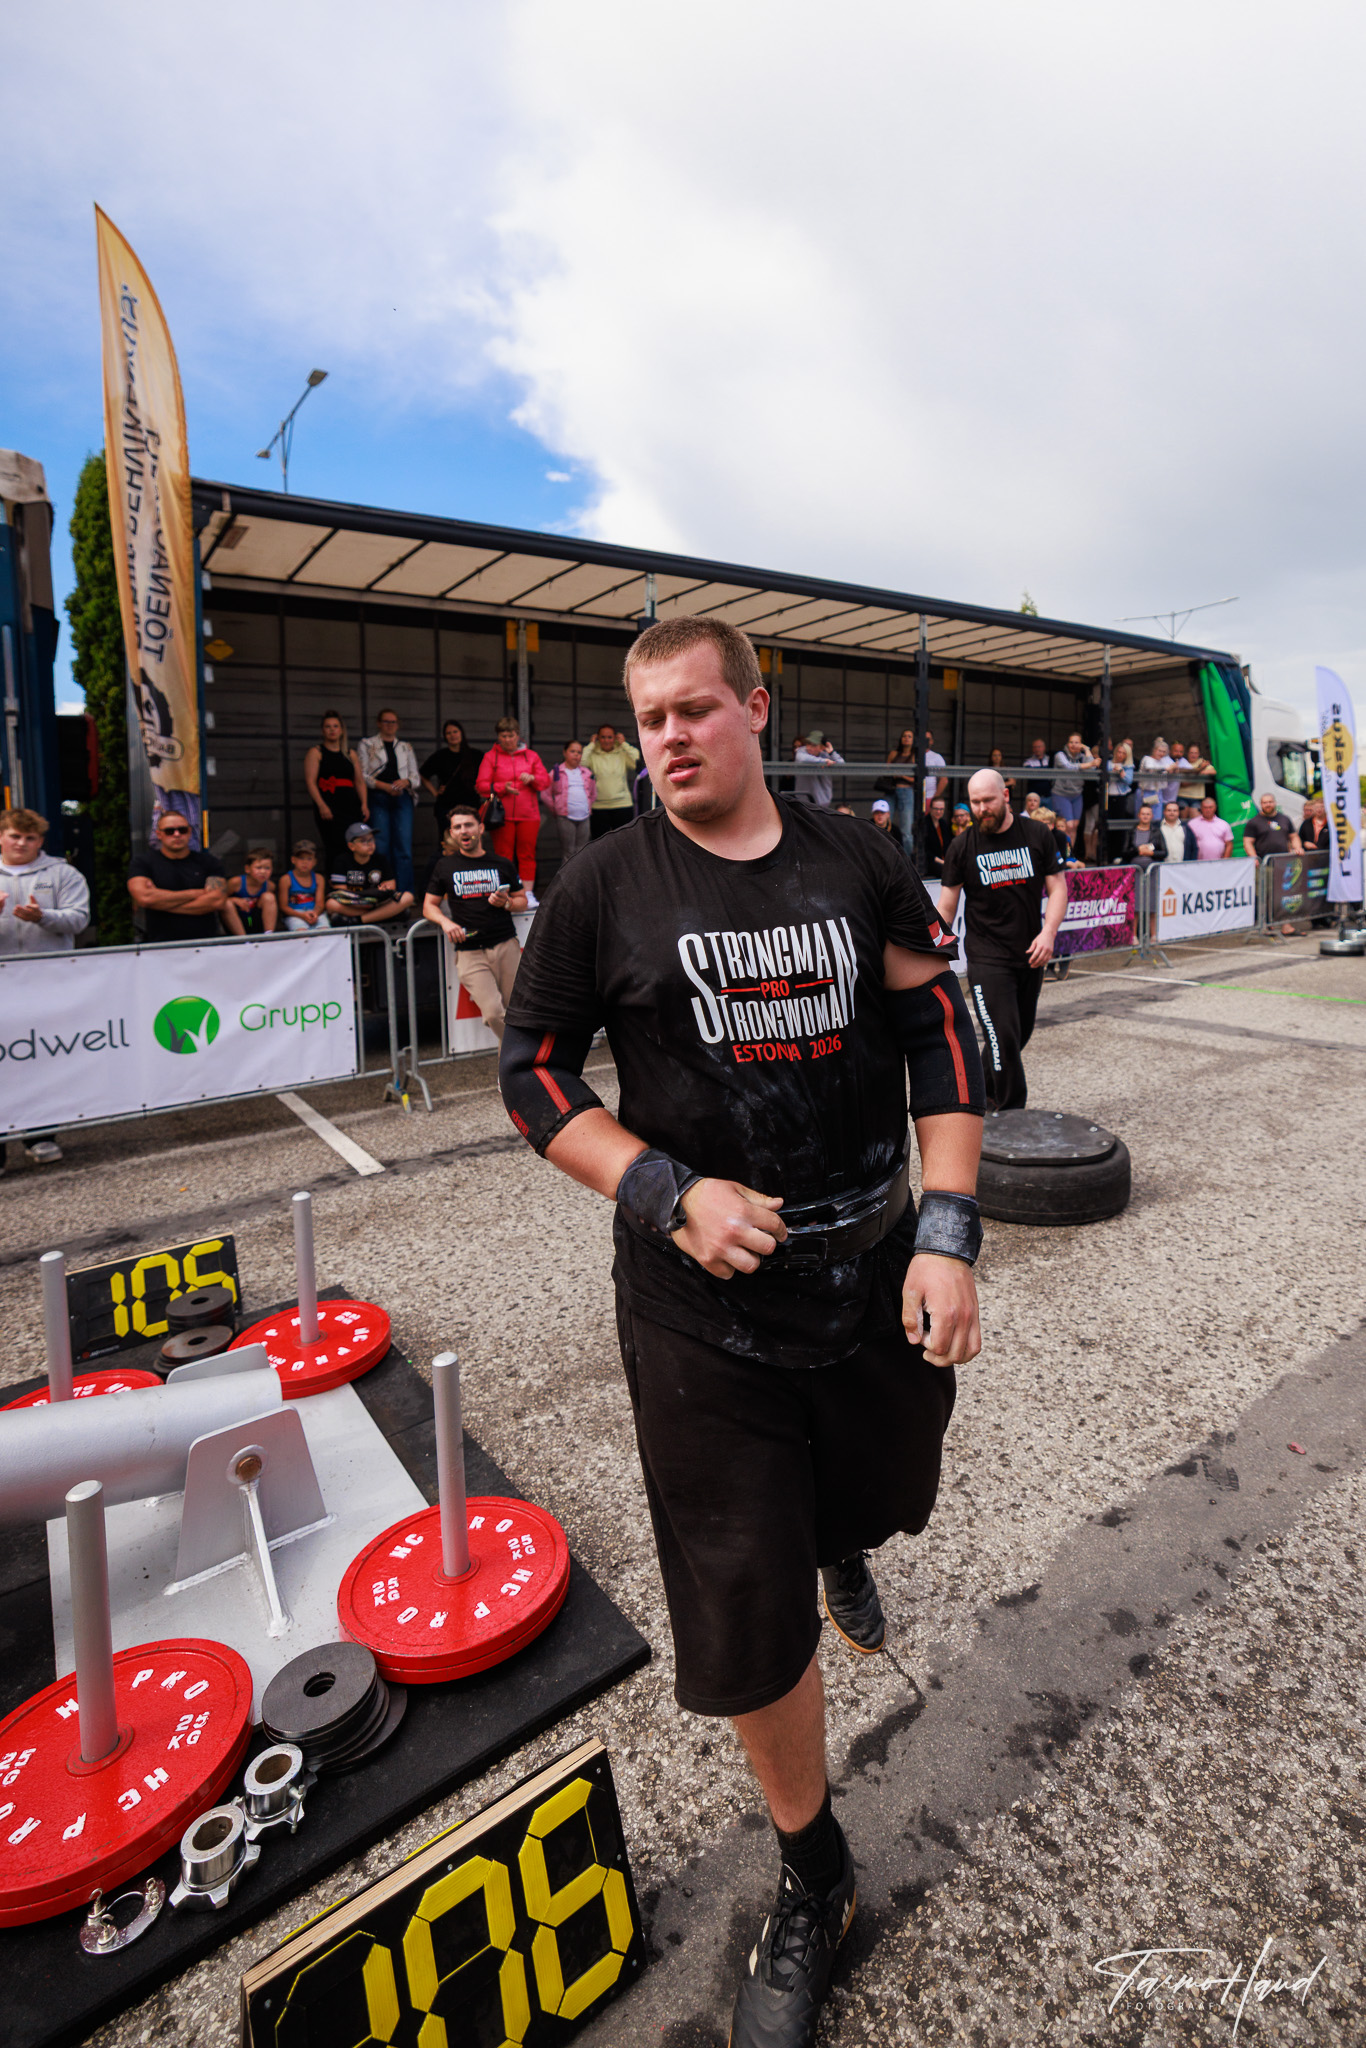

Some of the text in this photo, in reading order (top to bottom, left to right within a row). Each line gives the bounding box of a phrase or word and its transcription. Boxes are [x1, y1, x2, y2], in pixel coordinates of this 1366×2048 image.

[1182, 886, 1252, 914] KASTELLI
[678, 916, 858, 1019] STRONGMAN
[761, 980, 790, 999] PRO
[0, 1001, 342, 1062] dwell Grupp
[973, 984, 1002, 1071] RAMMUKOOBAS
[733, 1034, 842, 1063] ESTONIA 2026
[389, 1515, 514, 1559] HC RO
[508, 1534, 533, 1551] 25
[512, 1544, 536, 1560] KG
[372, 1577, 400, 1595] 25
[500, 1568, 534, 1597] HC
[374, 1589, 401, 1607] KG
[132, 1668, 210, 1700] PRO
[178, 1711, 210, 1733] 25
[168, 1730, 201, 1750] KG
[118, 1766, 171, 1812] HC
